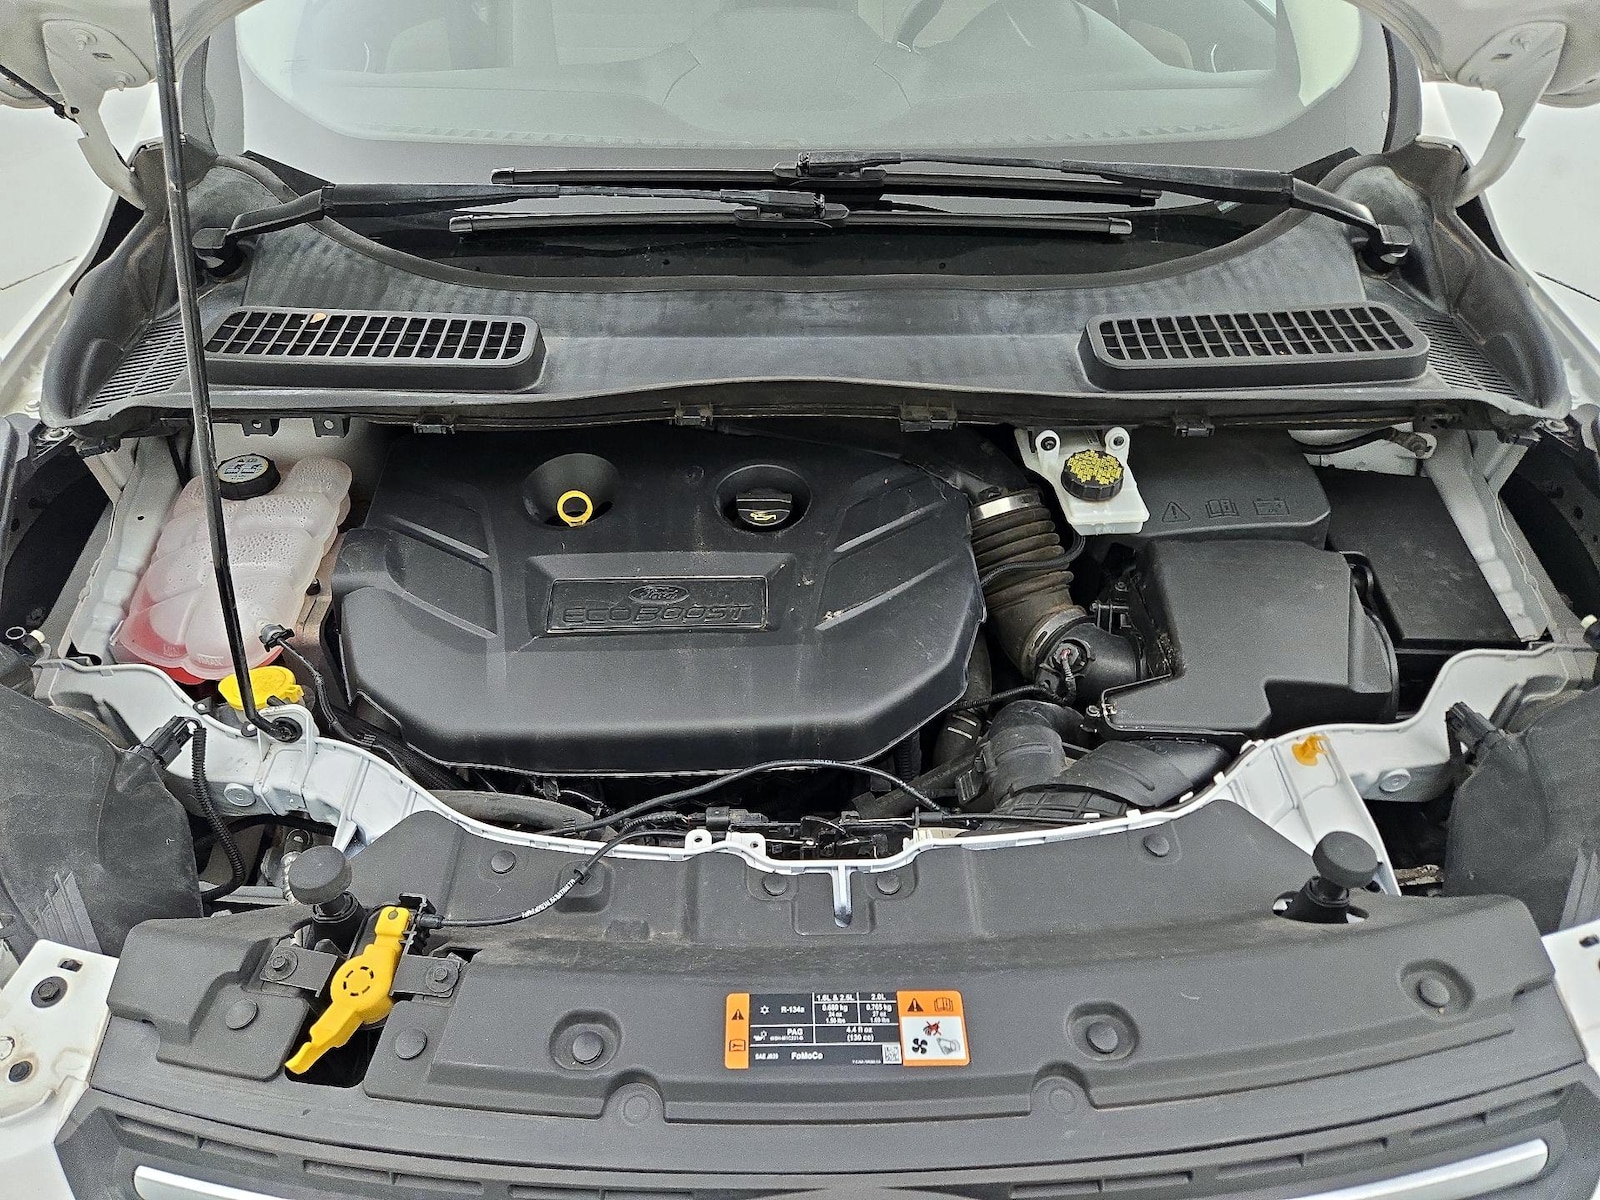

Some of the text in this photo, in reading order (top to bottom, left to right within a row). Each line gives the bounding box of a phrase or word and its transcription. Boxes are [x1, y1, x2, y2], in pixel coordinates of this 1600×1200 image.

[562, 602, 753, 625] ECOBOOST
[840, 1004, 848, 1012] kg
[884, 1004, 892, 1012] kg
[791, 1051, 823, 1060] FoMoCo
